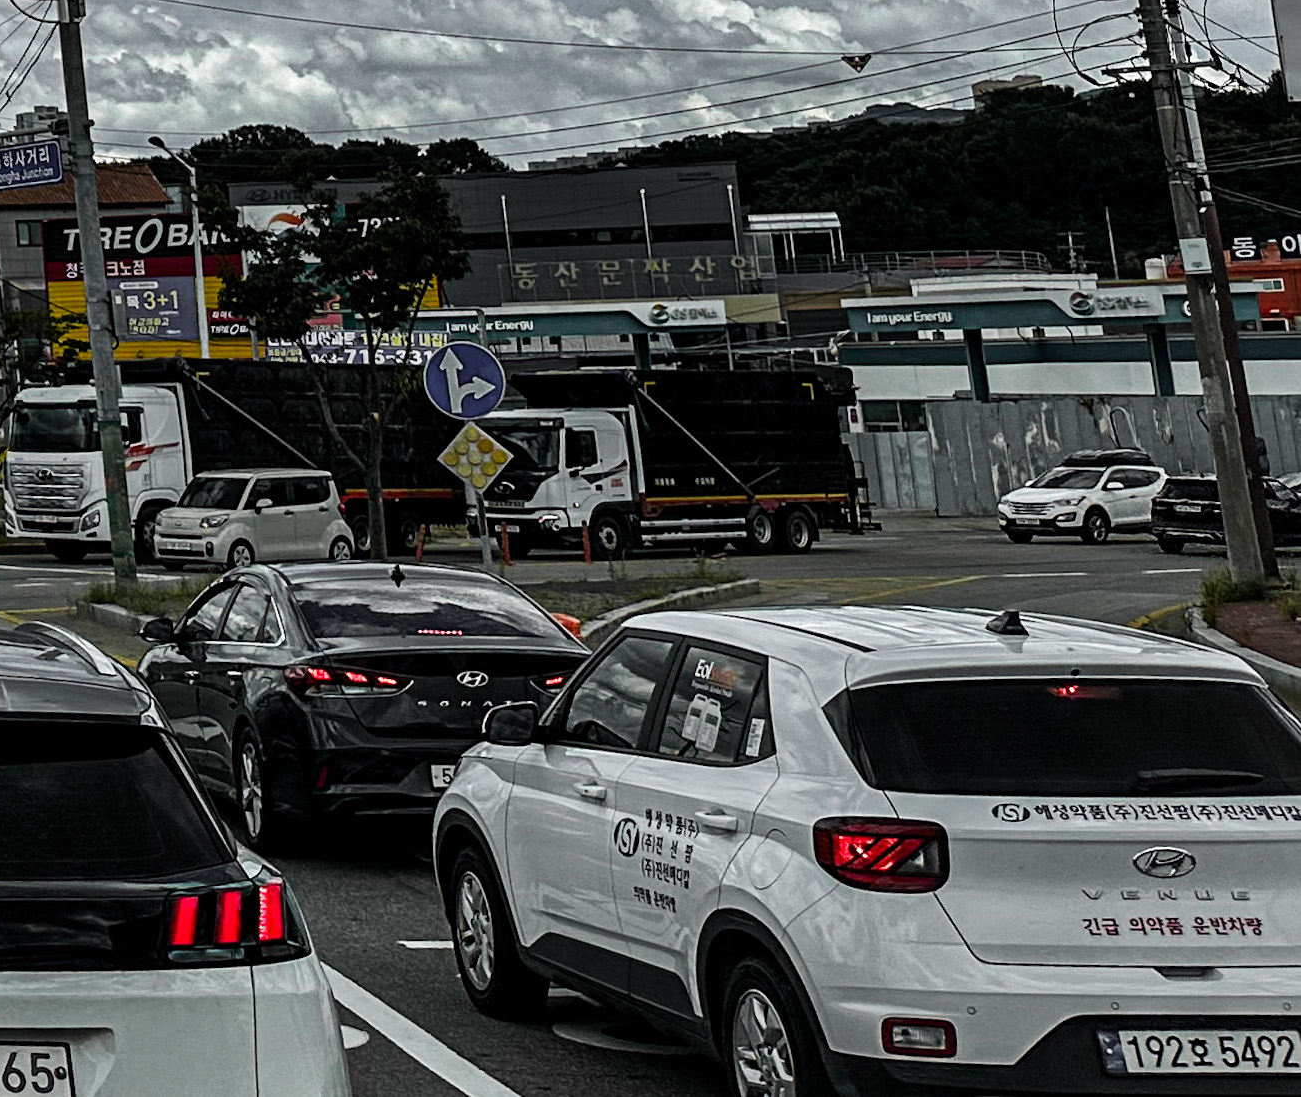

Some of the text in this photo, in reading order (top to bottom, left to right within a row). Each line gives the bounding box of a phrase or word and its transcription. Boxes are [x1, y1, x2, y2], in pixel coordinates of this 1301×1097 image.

[142, 290, 179, 311] 3+1
[494, 320, 534, 332] Energy
[913, 311, 953, 325] Energy
[1081, 888, 1252, 901] VENUE
[1082, 916, 1263, 936] 긴급 의약품 운반차량
[1126, 1035, 1299, 1070] 192호 5492
